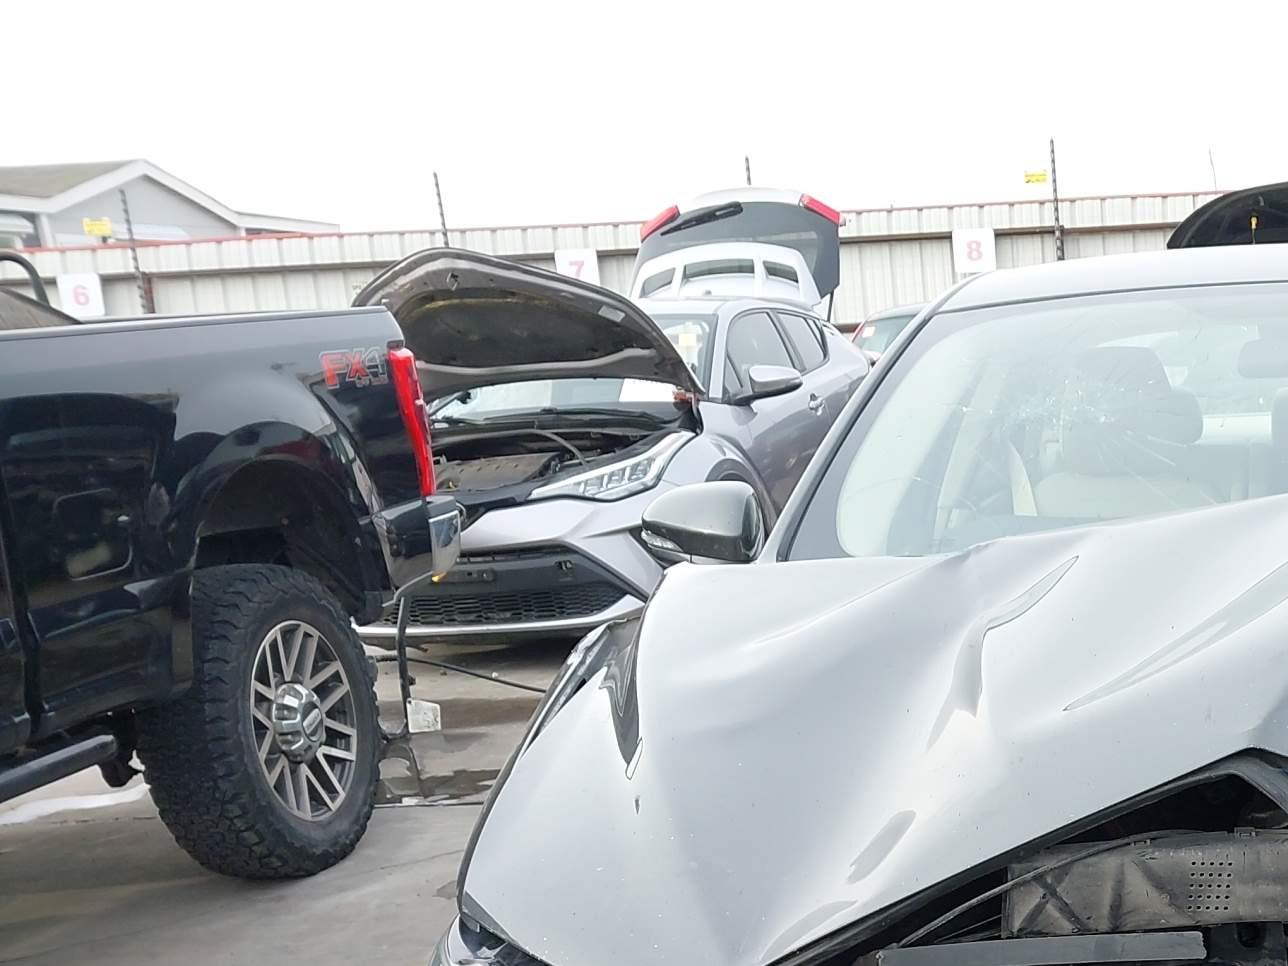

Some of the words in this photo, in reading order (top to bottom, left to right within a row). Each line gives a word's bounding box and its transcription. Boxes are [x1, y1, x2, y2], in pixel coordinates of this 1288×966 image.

[966, 240, 983, 262] 8
[568, 259, 585, 278] 7
[73, 284, 90, 306] 6
[319, 346, 389, 389] FX4
